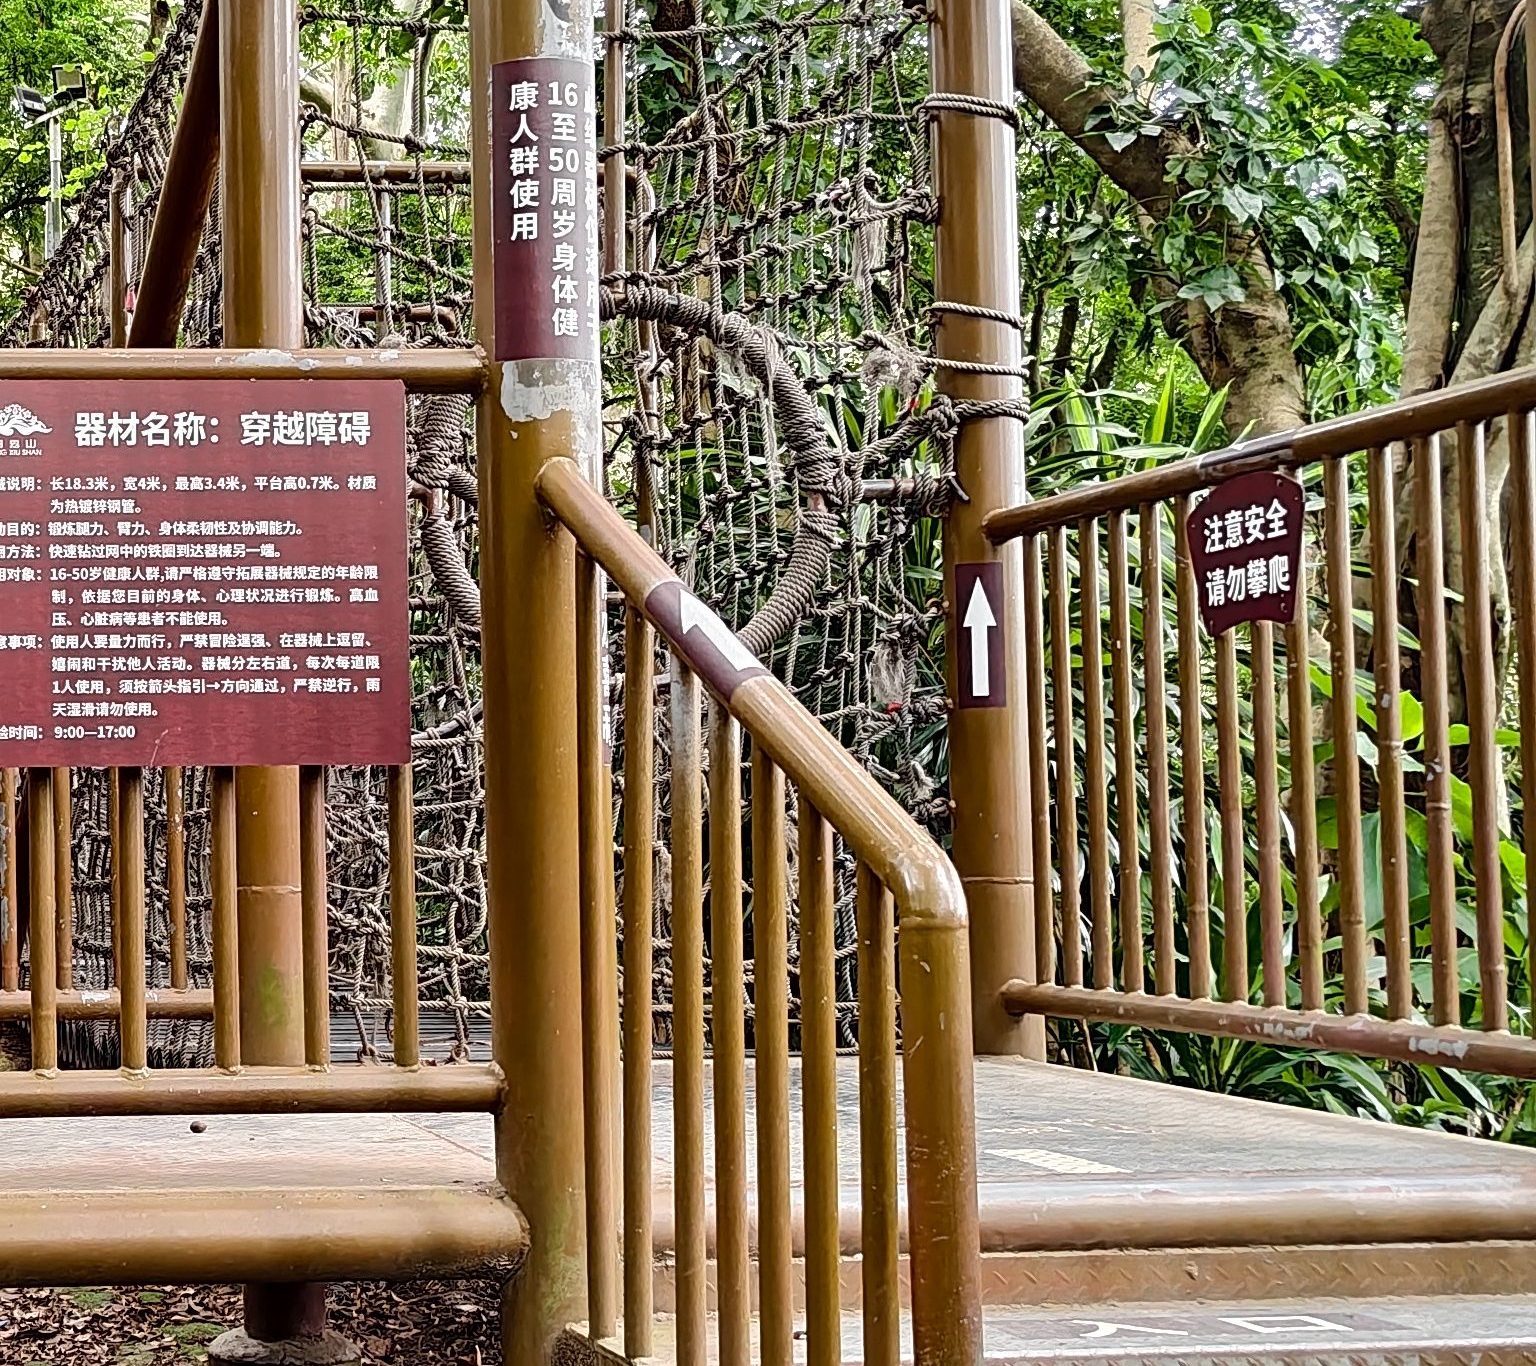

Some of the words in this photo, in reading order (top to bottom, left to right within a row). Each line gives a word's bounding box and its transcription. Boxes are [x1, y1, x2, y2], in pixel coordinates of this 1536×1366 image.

[509, 80, 540, 241] 康人群使用
[547, 80, 580, 337] 16至50周岁身体健
[74, 410, 372, 447] 器材名称：穿越障碍
[1203, 498, 1288, 554] 注意安全
[1205, 554, 1291, 607] 请勿攀爬
[1072, 1314, 1355, 1338] 入口
